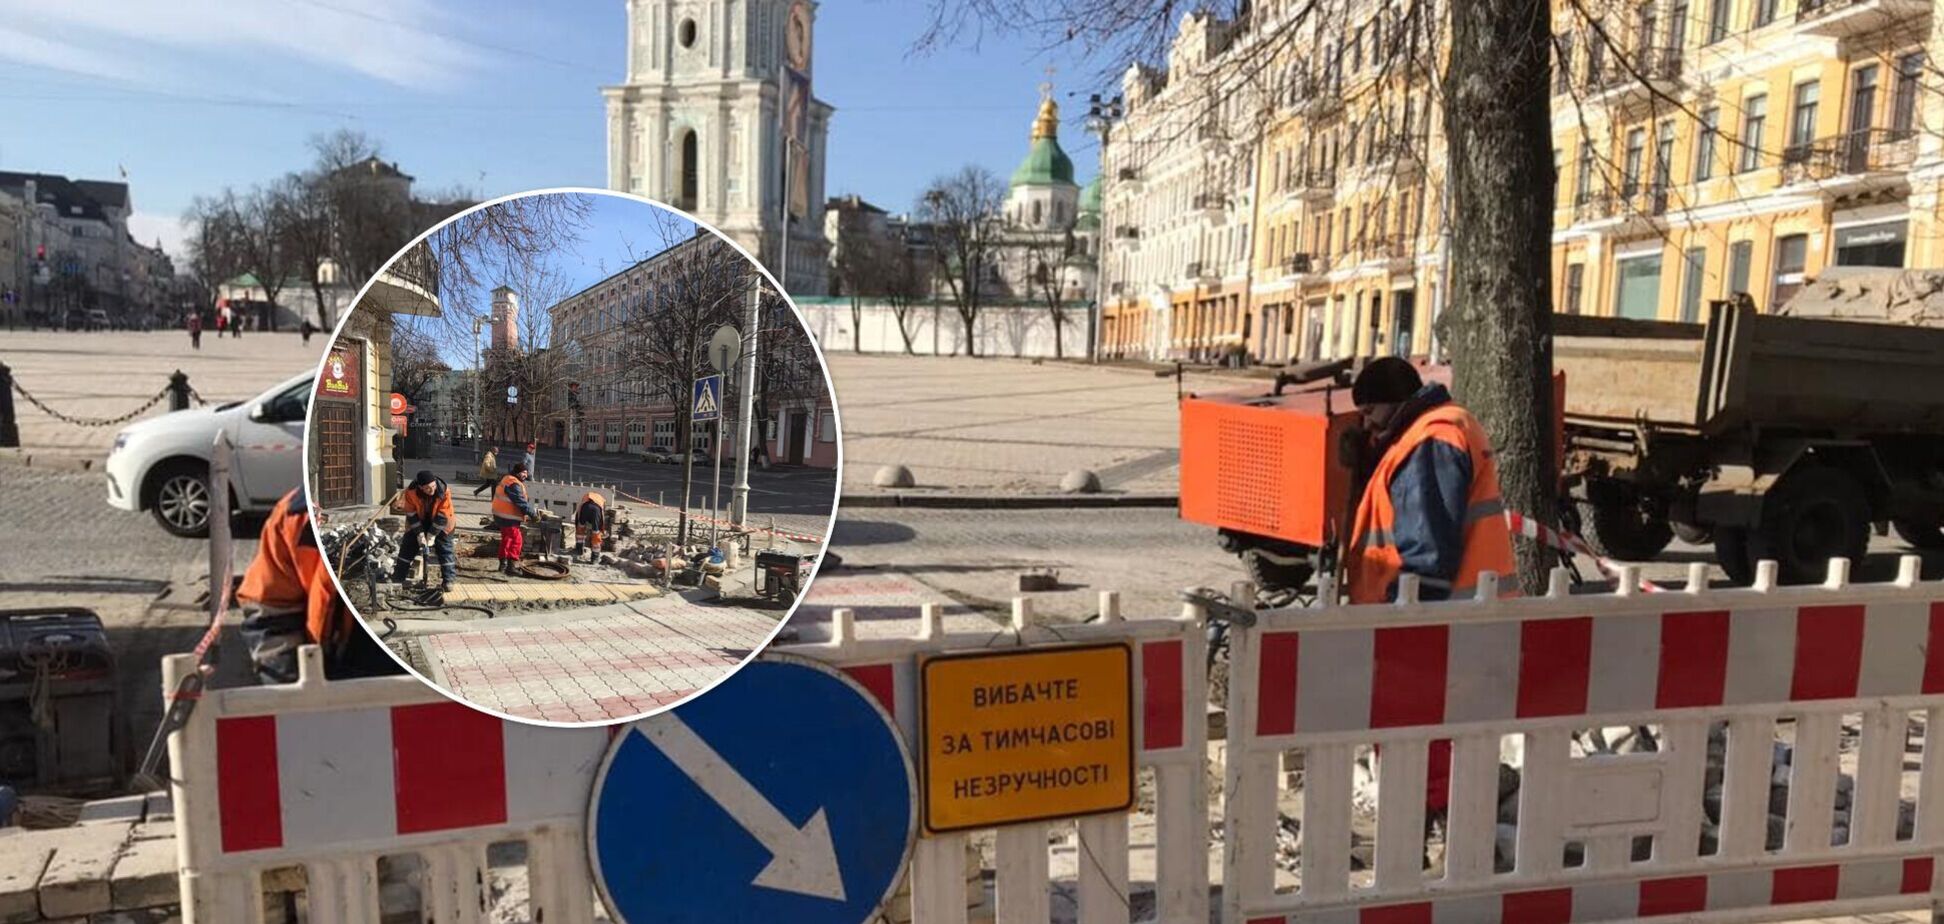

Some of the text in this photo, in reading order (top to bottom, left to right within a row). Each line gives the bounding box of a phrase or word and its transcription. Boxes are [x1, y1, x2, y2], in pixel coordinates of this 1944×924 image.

[973, 679, 1079, 708] ВИБАЧТЕ
[942, 719, 1115, 755] ЗА ТИМЧАСОВІ
[953, 764, 1109, 799] НЕЗРУЧНОСТІ
